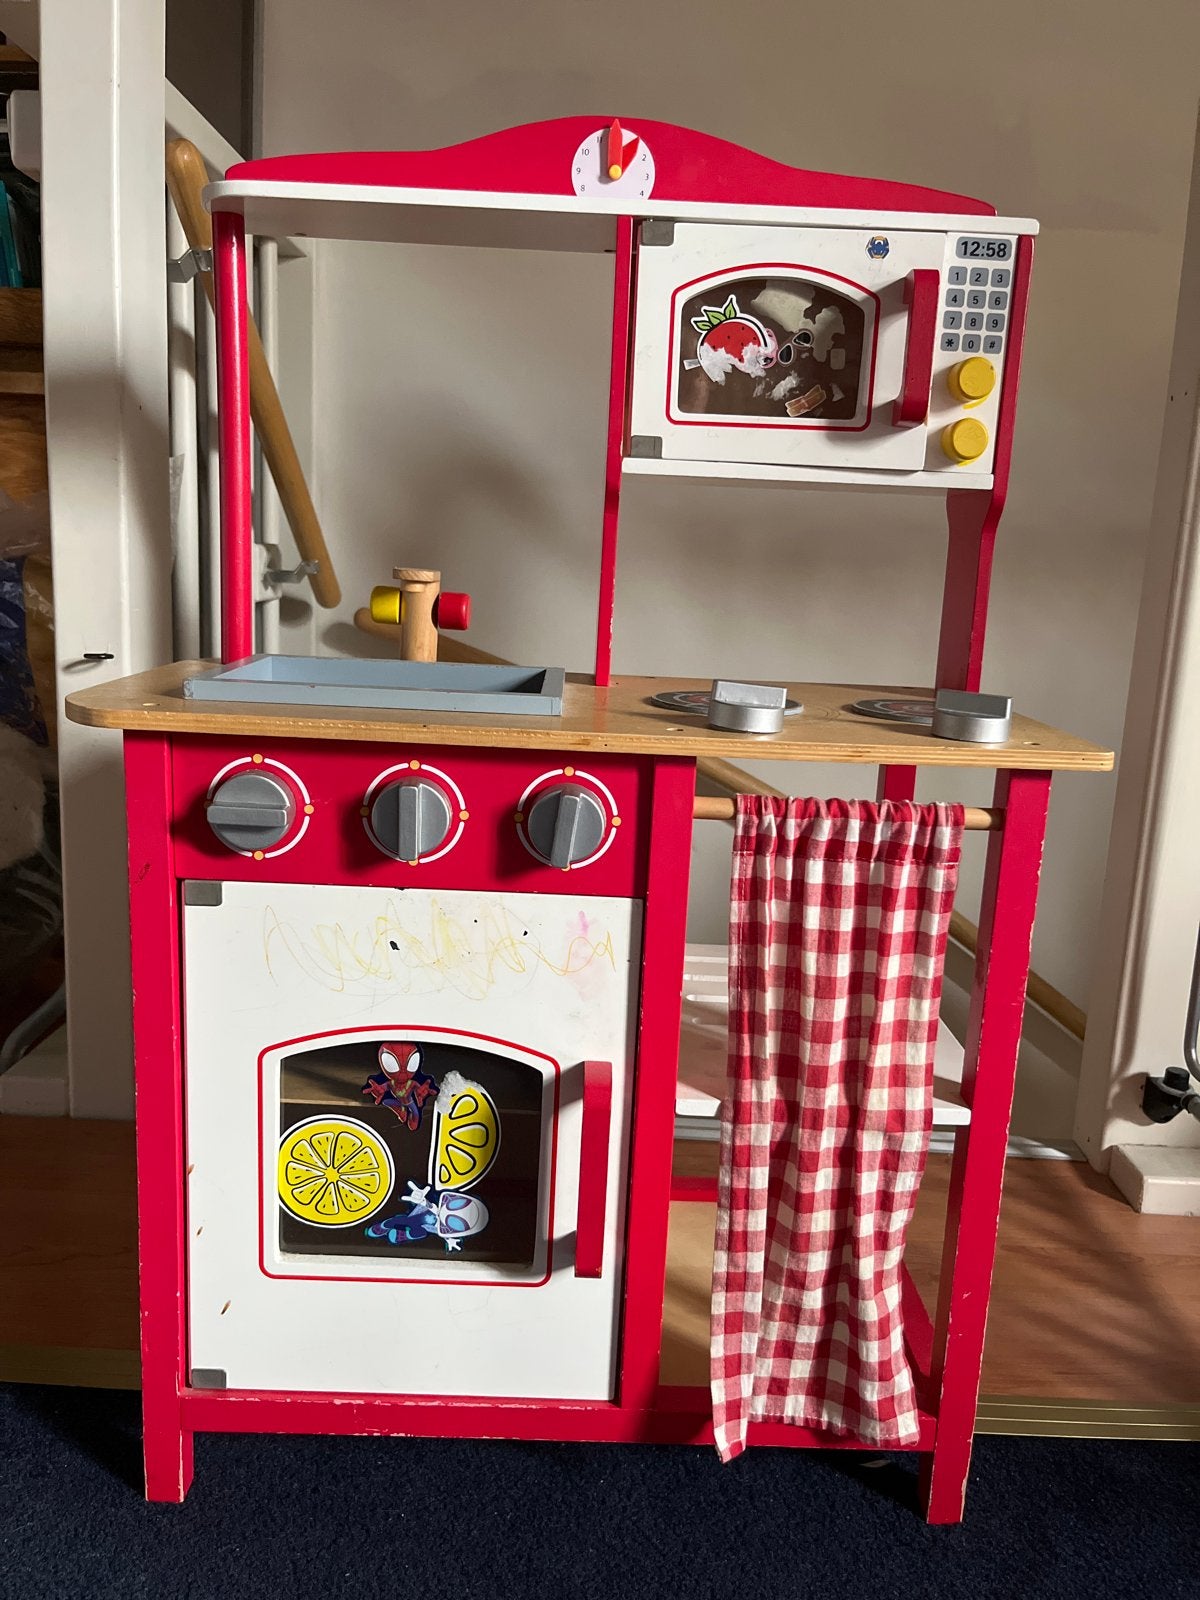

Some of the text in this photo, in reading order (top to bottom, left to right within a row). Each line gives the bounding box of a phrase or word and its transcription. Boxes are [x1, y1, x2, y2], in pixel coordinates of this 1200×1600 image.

[581, 148, 590, 156] 10
[645, 173, 650, 181] 3
[580, 184, 585, 192] 8
[960, 240, 1008, 259] 12:58
[955, 271, 1003, 283] 1 2 3
[951, 294, 1001, 306] 4 5 6
[949, 316, 998, 328] 7 8 9
